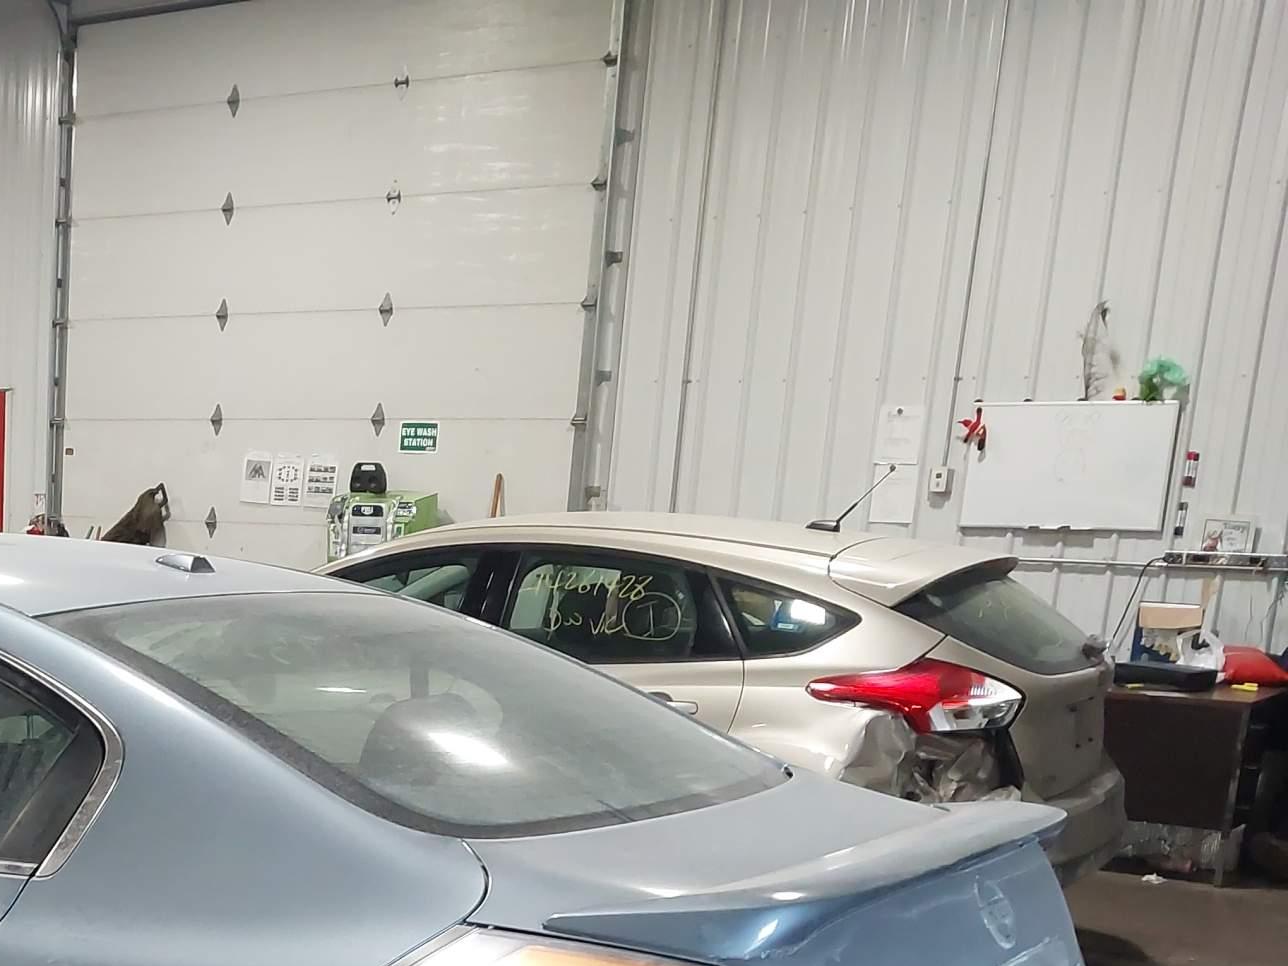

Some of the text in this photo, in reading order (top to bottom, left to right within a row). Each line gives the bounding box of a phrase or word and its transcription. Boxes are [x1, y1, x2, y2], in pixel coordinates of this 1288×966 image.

[402, 427, 437, 437] EYE WASH
[403, 438, 434, 447] STATION
